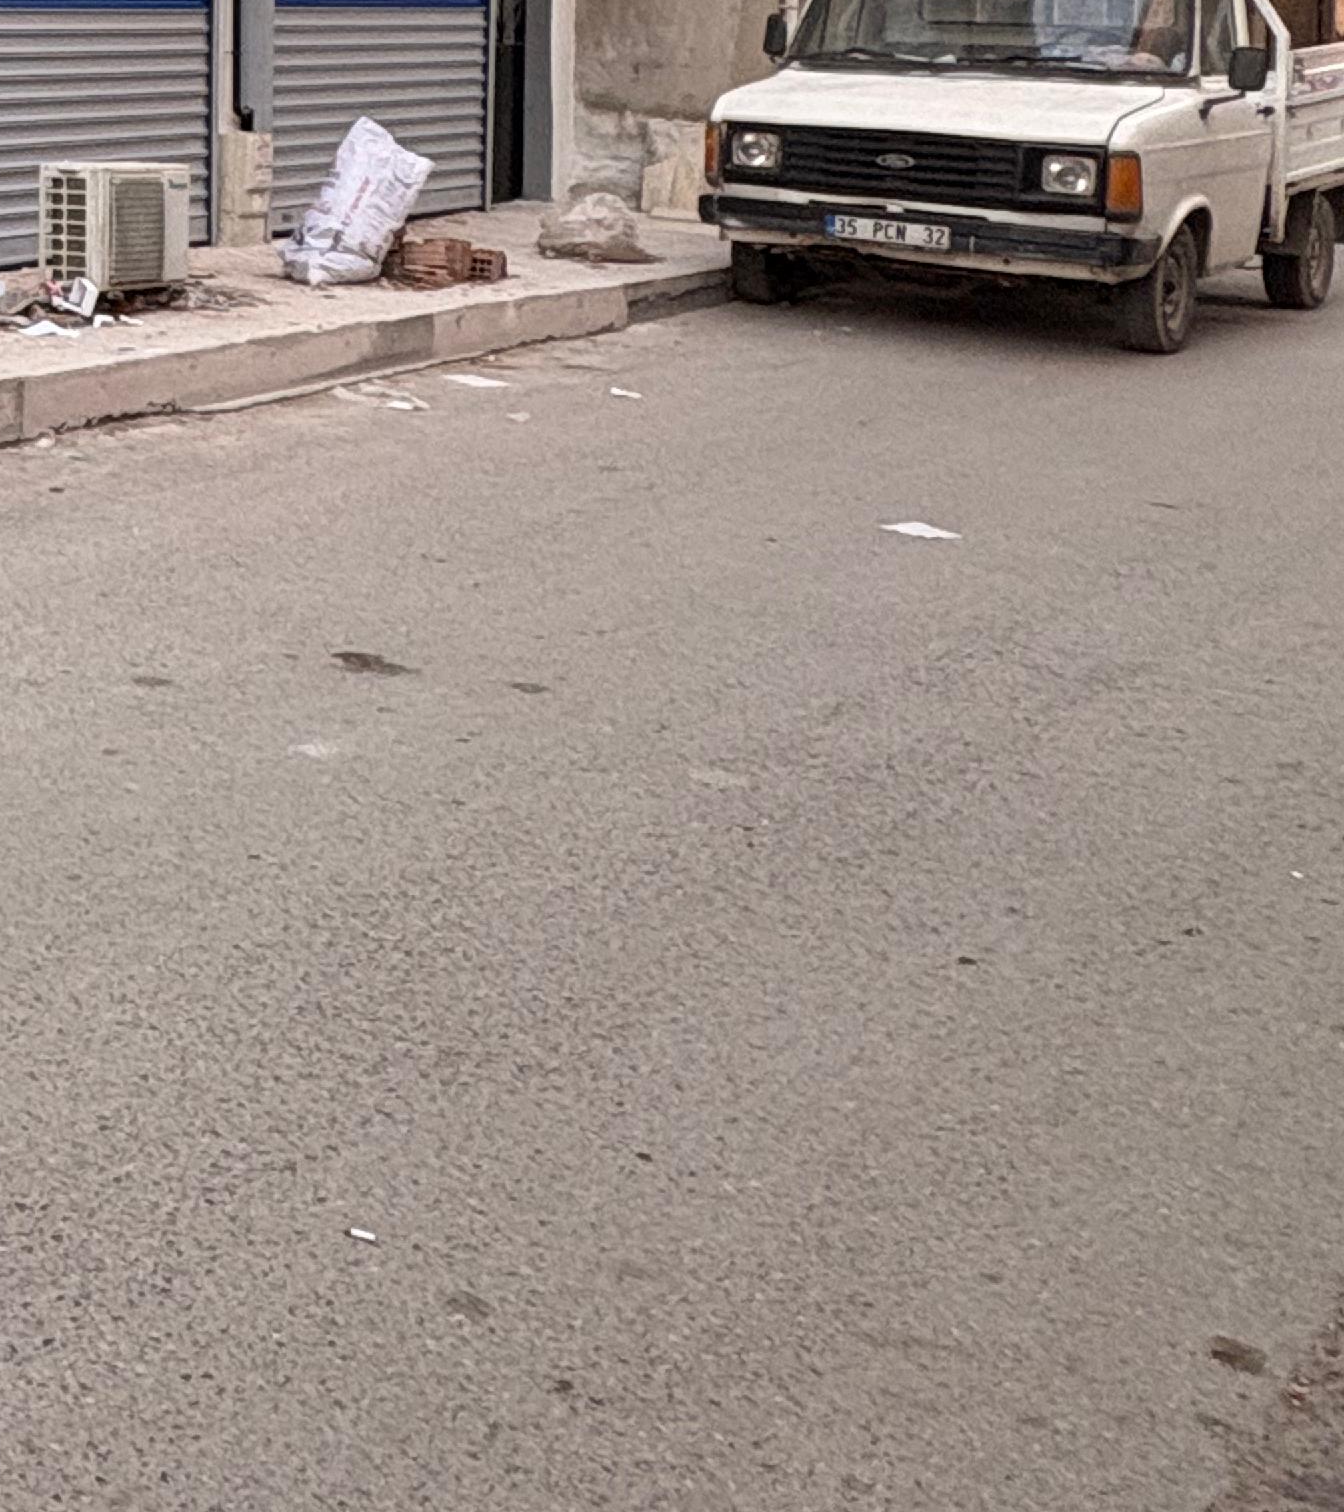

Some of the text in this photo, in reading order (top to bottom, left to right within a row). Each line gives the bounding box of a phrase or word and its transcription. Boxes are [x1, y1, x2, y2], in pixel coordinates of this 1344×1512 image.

[836, 218, 945, 245] 35 PCN 32
